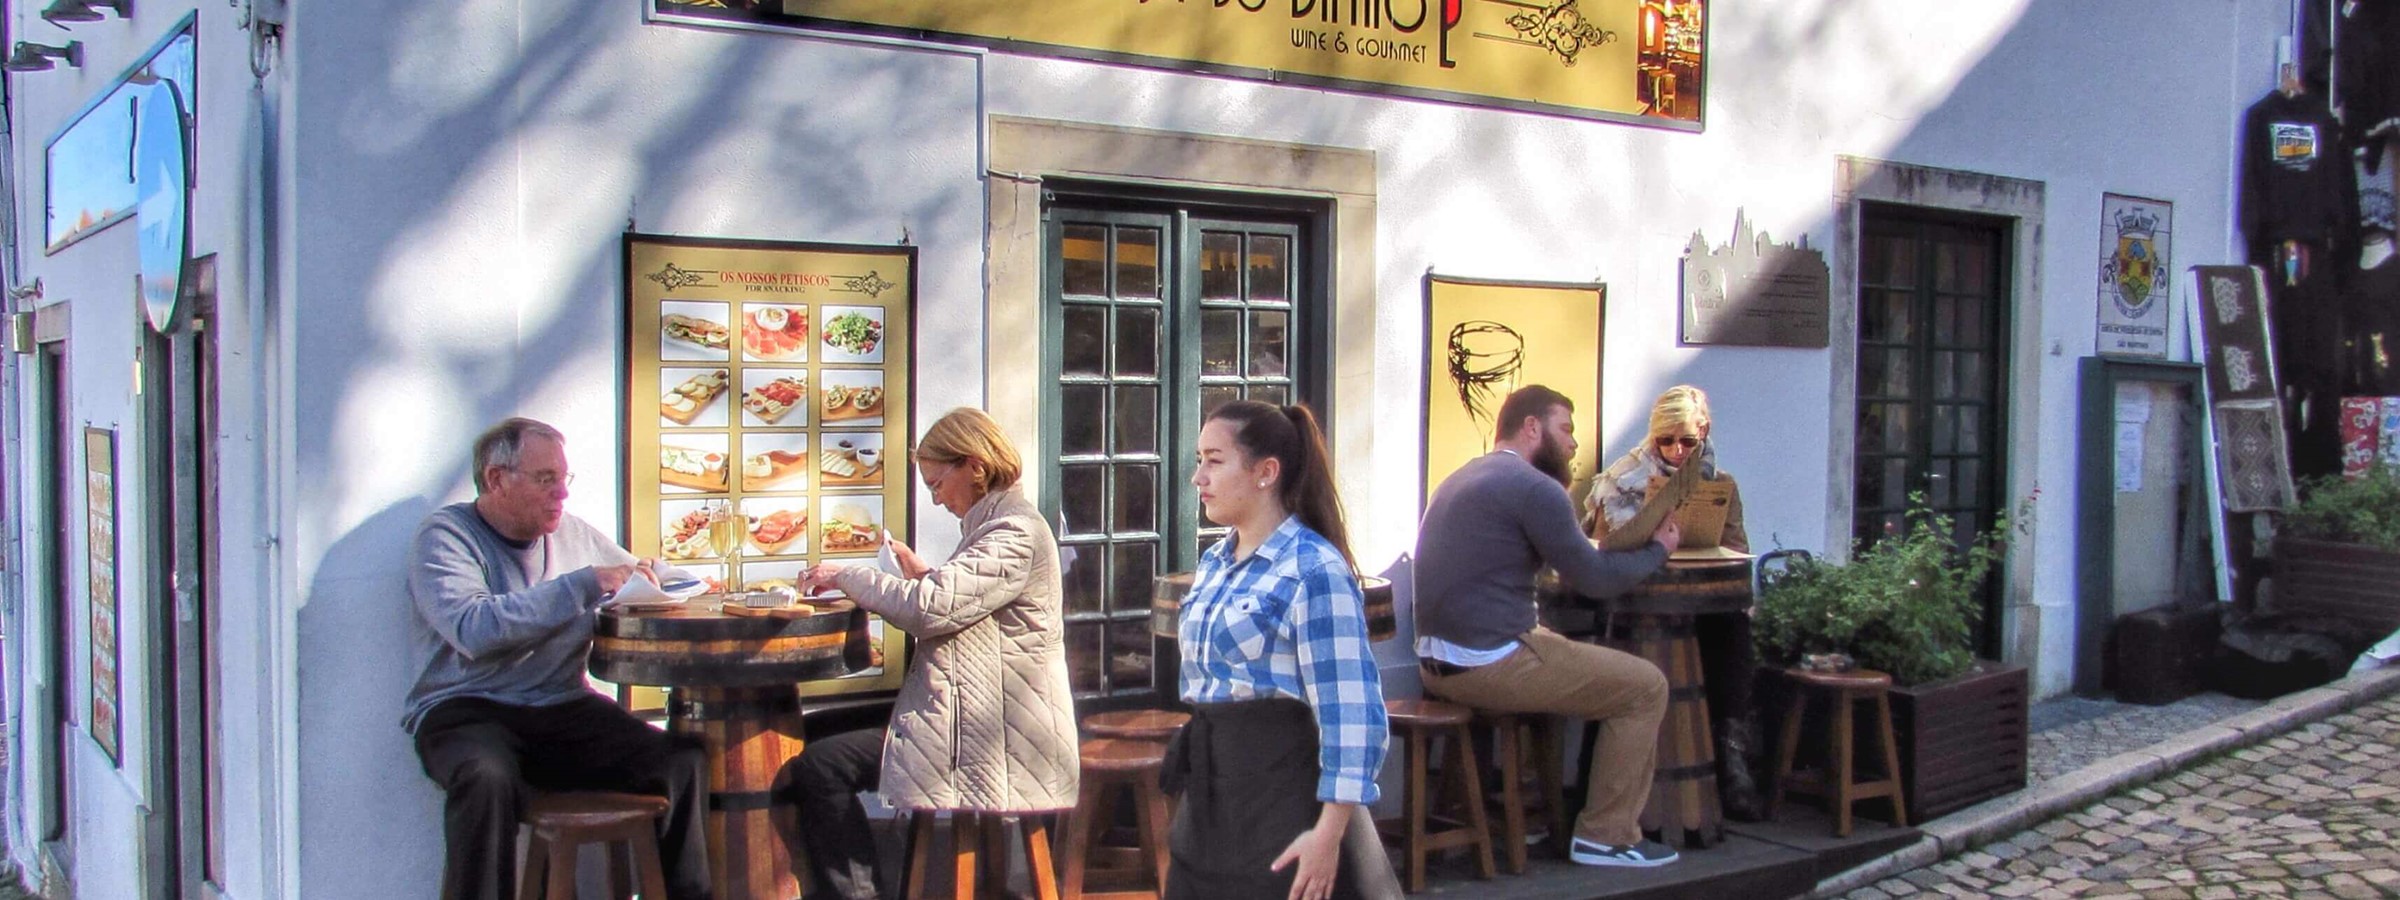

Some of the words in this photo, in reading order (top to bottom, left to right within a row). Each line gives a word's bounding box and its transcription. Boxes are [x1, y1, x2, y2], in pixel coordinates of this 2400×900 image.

[1291, 28, 1327, 51] WINE
[1334, 31, 1349, 54] &
[1356, 37, 1427, 64] GOURMET
[720, 271, 734, 284] OS
[737, 271, 778, 285] NOSSOS
[780, 273, 830, 287] PETISCOS
[745, 284, 762, 293] FOR
[763, 286, 805, 294] SNACKING
